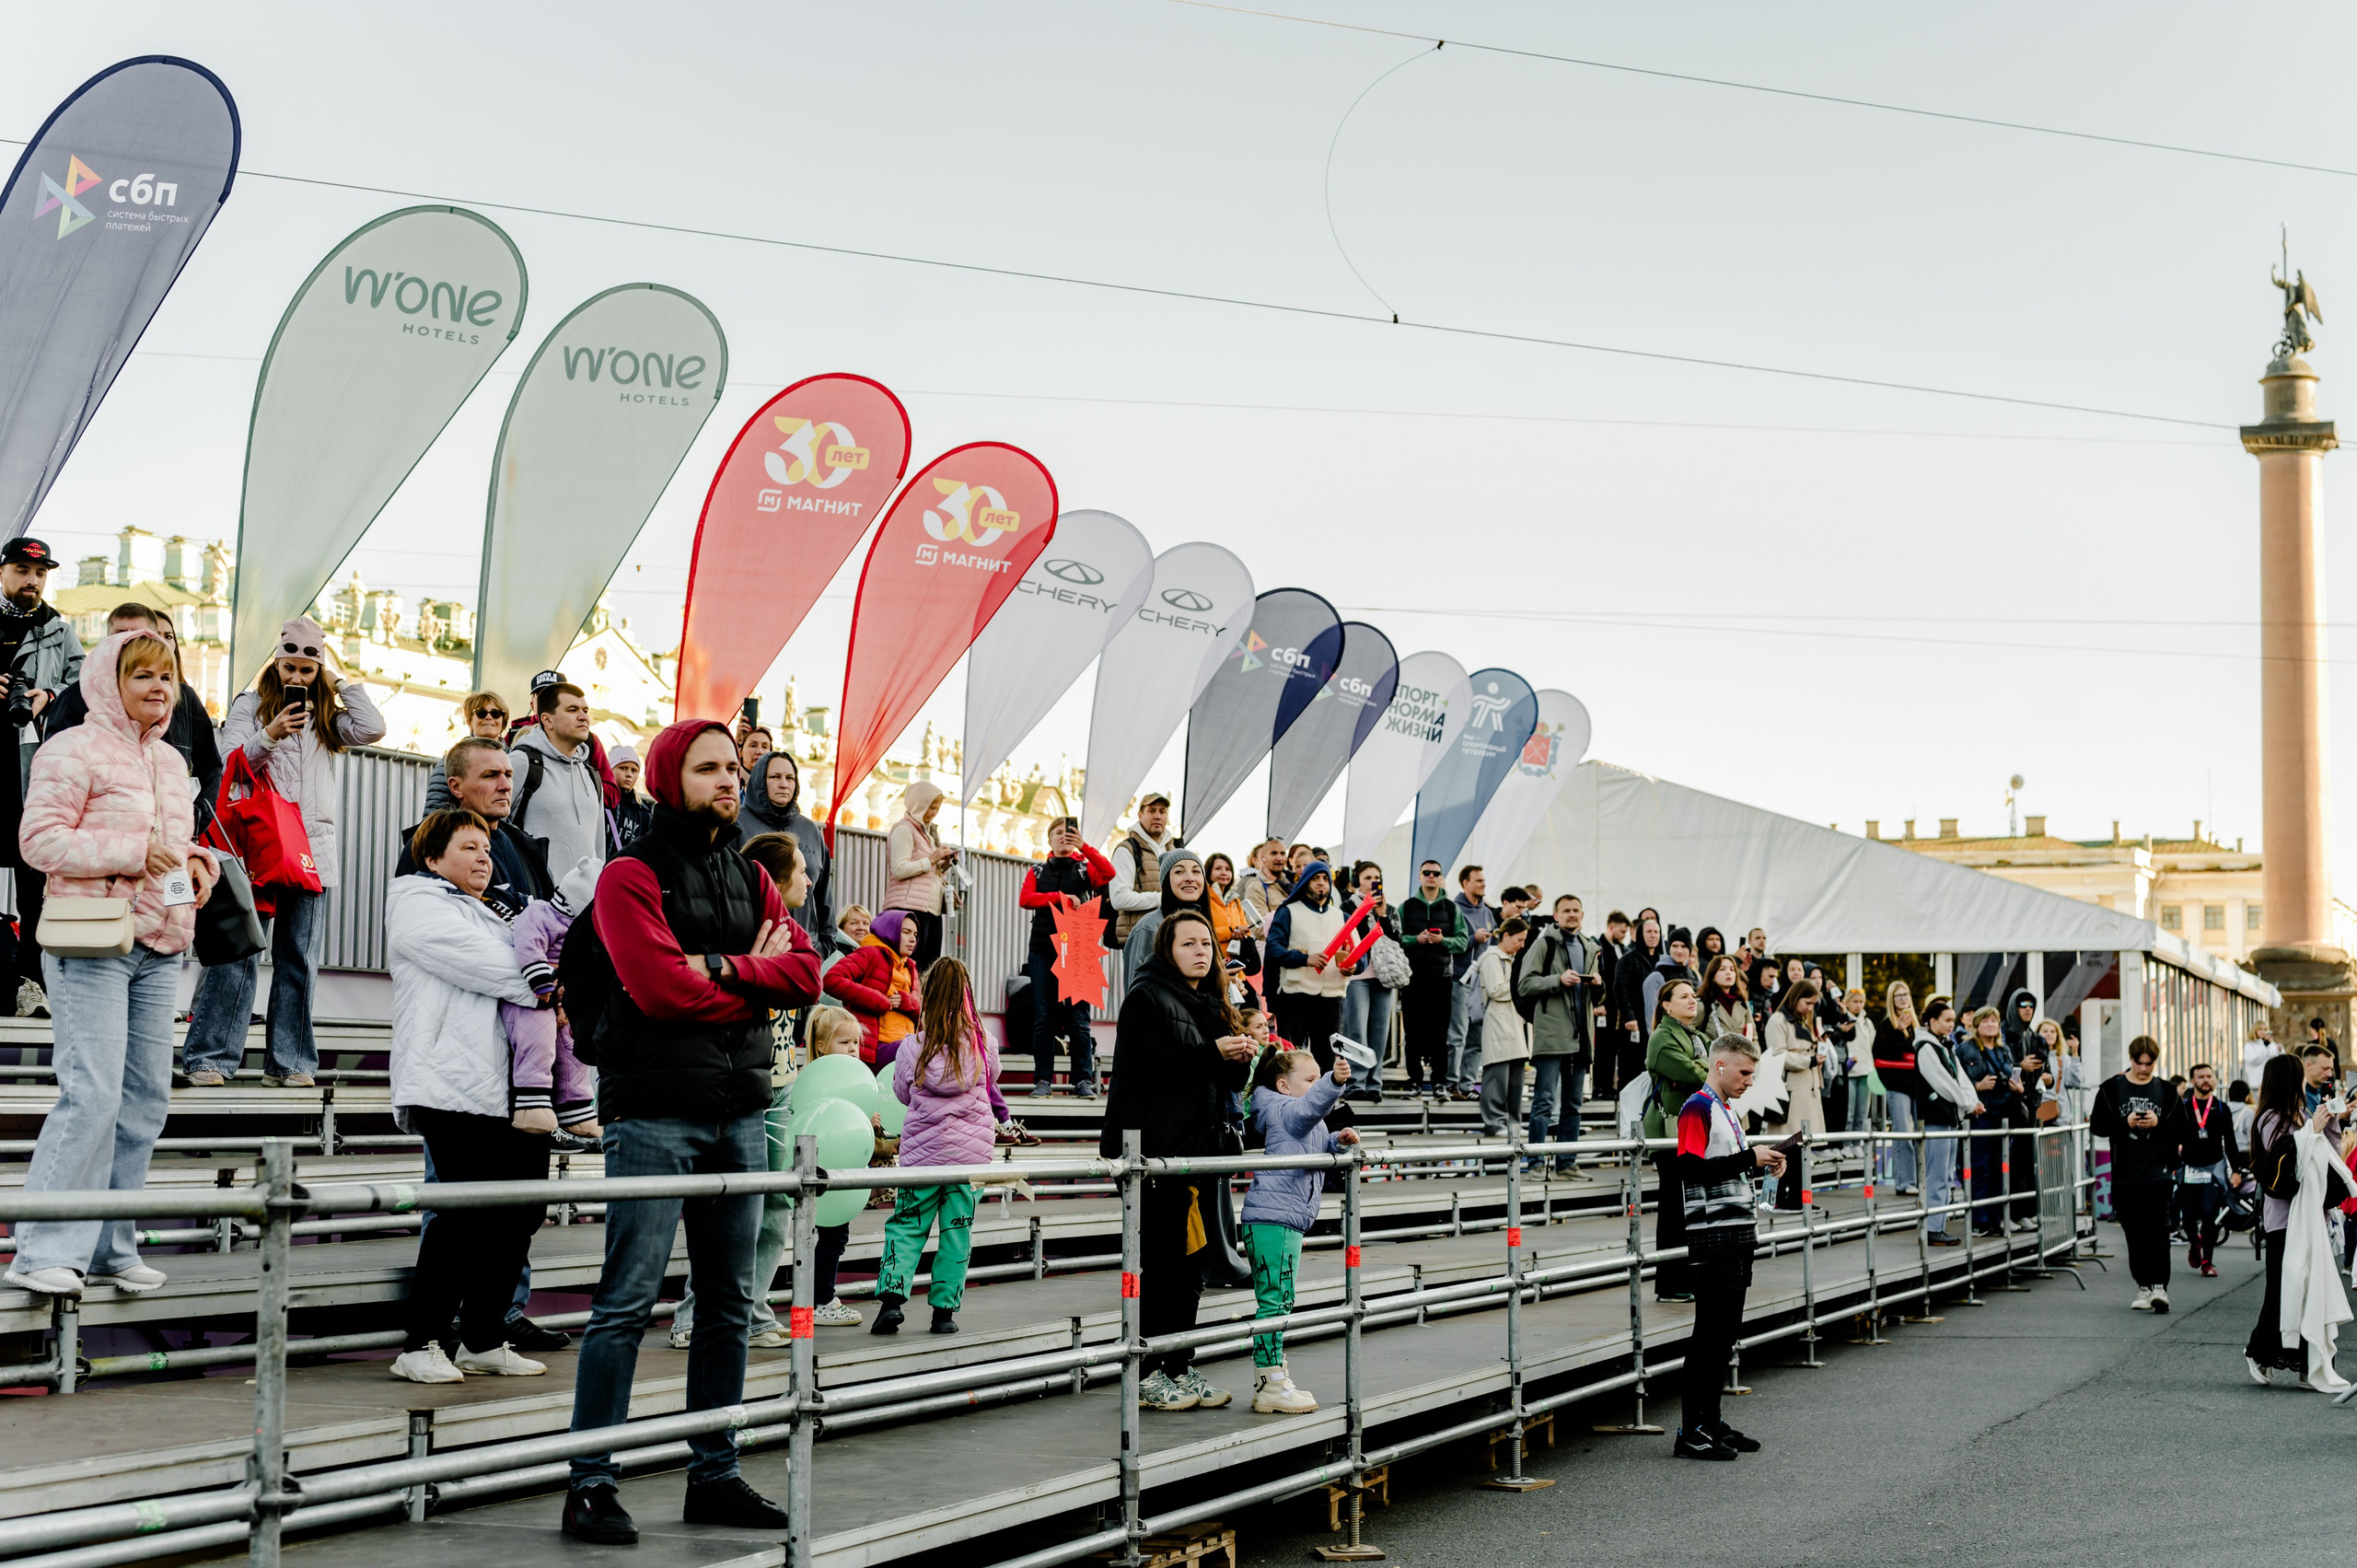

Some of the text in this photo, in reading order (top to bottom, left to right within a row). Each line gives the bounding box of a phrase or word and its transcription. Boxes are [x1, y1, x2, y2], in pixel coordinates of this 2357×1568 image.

[105, 222, 151, 232] платежей
[107, 210, 190, 225] система быстрых
[401, 322, 480, 345] HOTELS
[620, 393, 690, 406] HOTELS
[763, 415, 865, 489] 30 лет
[786, 495, 863, 517] МАГНИТ
[923, 477, 1016, 547] 30 лет
[942, 551, 1013, 574] МАГНИТ
[1016, 579, 1119, 614] CHERY
[1138, 608, 1227, 637] CHERY
[1395, 683, 1440, 707] ПОРТ
[1387, 700, 1446, 726] НОРМА
[1385, 715, 1444, 744] ЖИЗНИ
